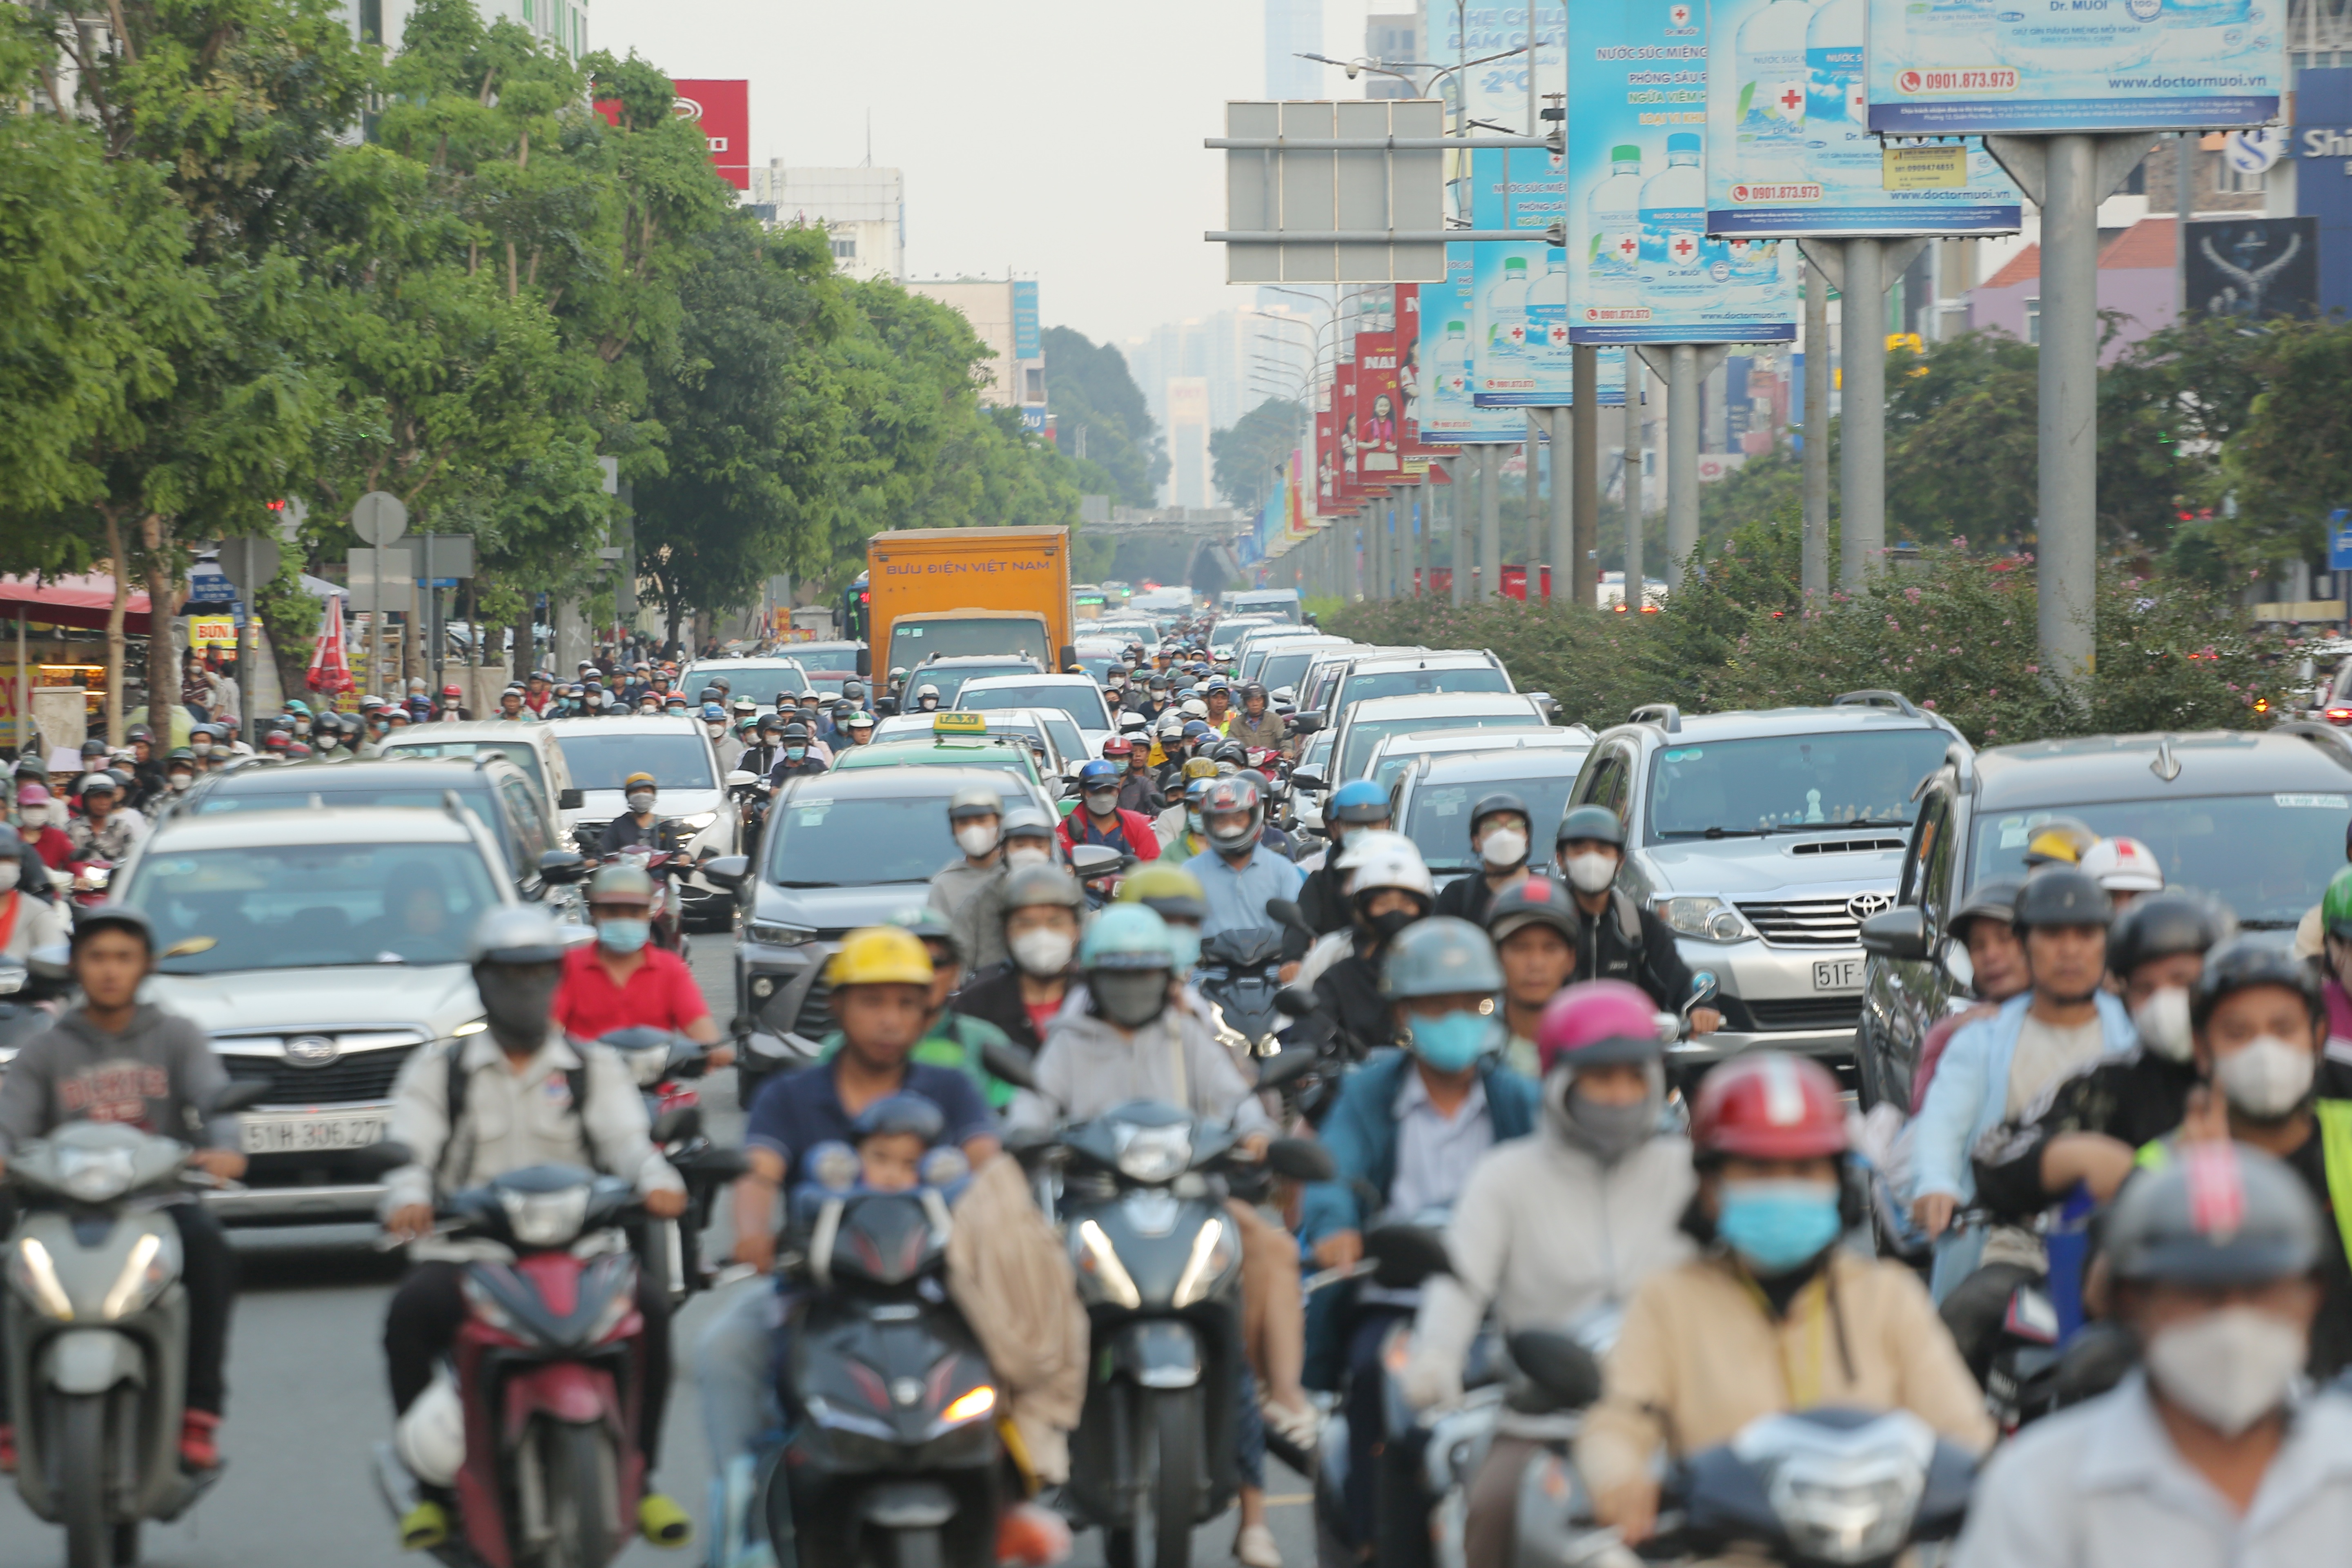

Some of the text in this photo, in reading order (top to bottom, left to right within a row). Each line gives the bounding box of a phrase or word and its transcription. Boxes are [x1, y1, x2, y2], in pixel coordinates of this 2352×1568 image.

[1927, 72, 2014, 89] 0901.873.973
[2109, 74, 2267, 89] www.doctormuoi.vn
[1752, 186, 1820, 200] 0901.873.973
[1891, 189, 2010, 200] www.doctormuoi.vn
[886, 559, 1050, 576] BƯU ĐIỆN VIỆT NAM
